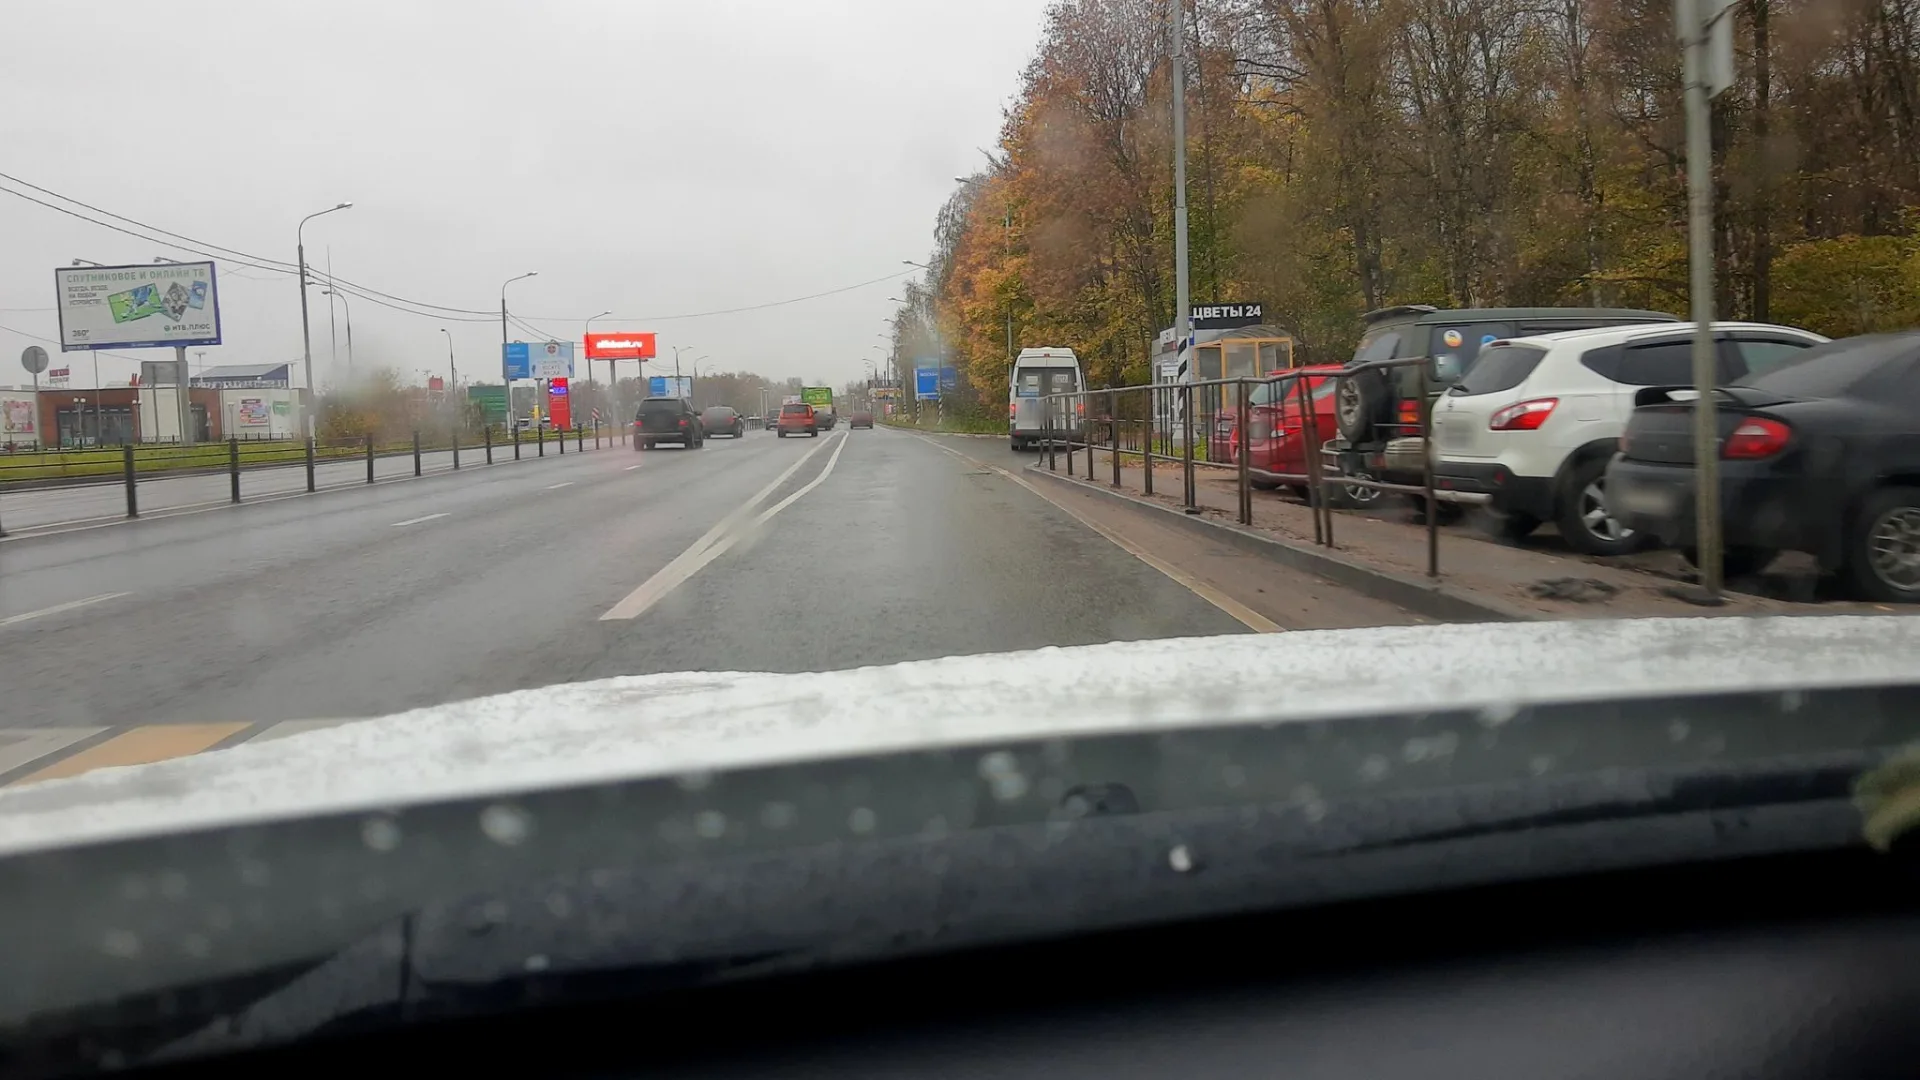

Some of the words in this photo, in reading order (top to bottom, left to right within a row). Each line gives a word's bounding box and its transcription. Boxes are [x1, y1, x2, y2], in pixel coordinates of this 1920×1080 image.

[67, 272, 136, 283] СПУТНИКОВОЕ
[139, 271, 146, 280] И
[149, 269, 190, 280] ОНЛАЙН
[1193, 306, 1242, 319] ЦВЕТЫ
[1245, 305, 1261, 316] 24
